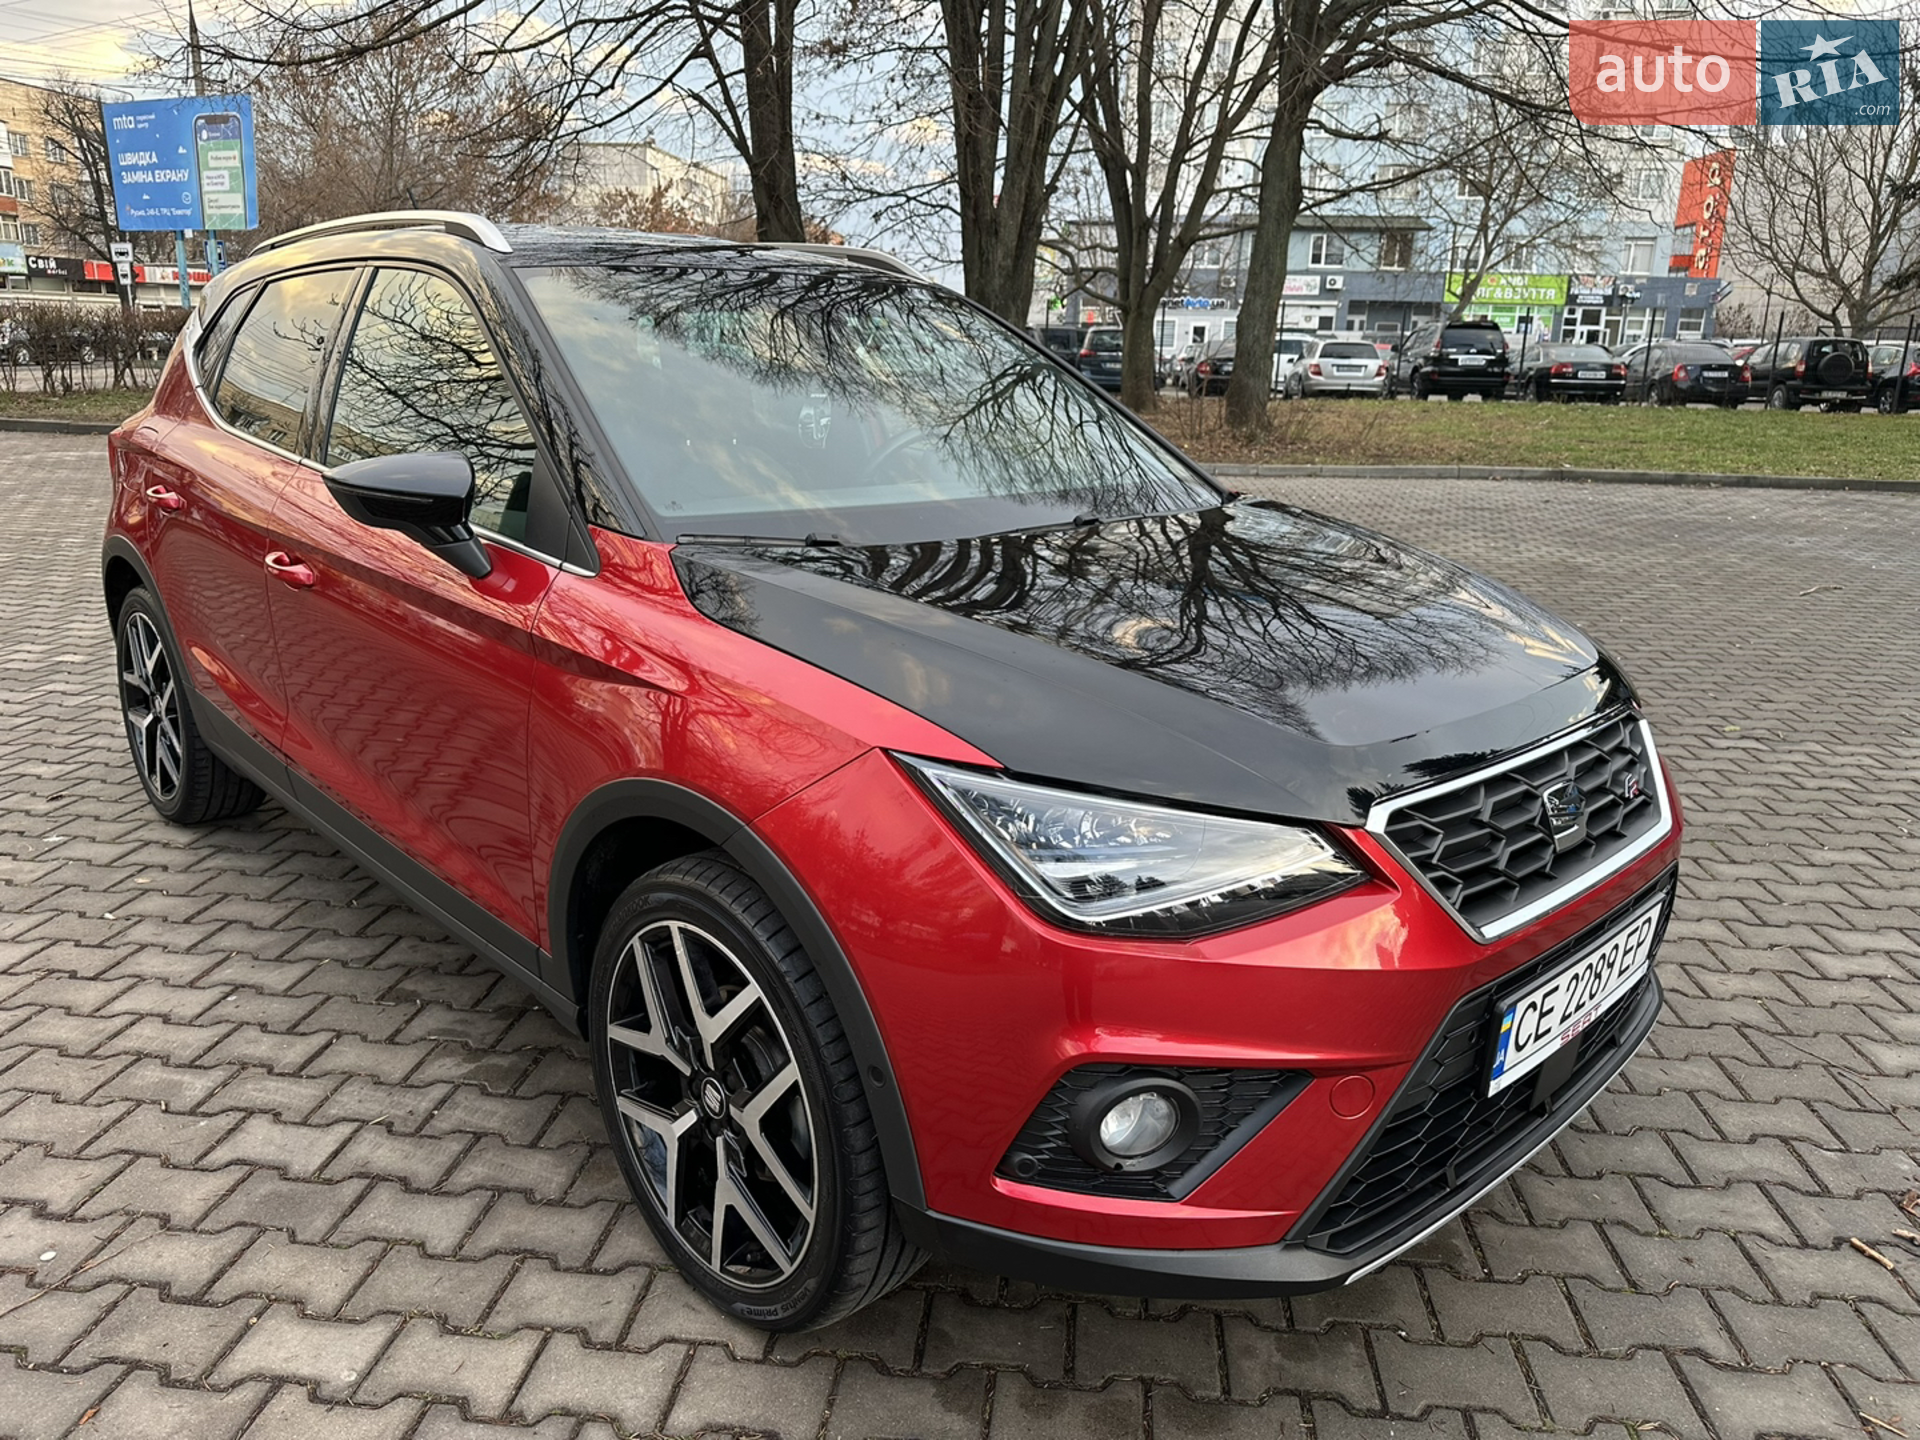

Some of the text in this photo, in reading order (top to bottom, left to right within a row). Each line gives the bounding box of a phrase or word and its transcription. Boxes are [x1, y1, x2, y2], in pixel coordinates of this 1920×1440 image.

[112, 113, 135, 130] mta
[118, 151, 158, 167] ШВИДКА
[121, 170, 154, 184] ЗАМІНА
[154, 168, 189, 183] ЕКРАНУ
[28, 256, 57, 269] СВІЙ
[1514, 915, 1652, 1052] CE 2289 EP
[1559, 1003, 1602, 1047] SEAT
